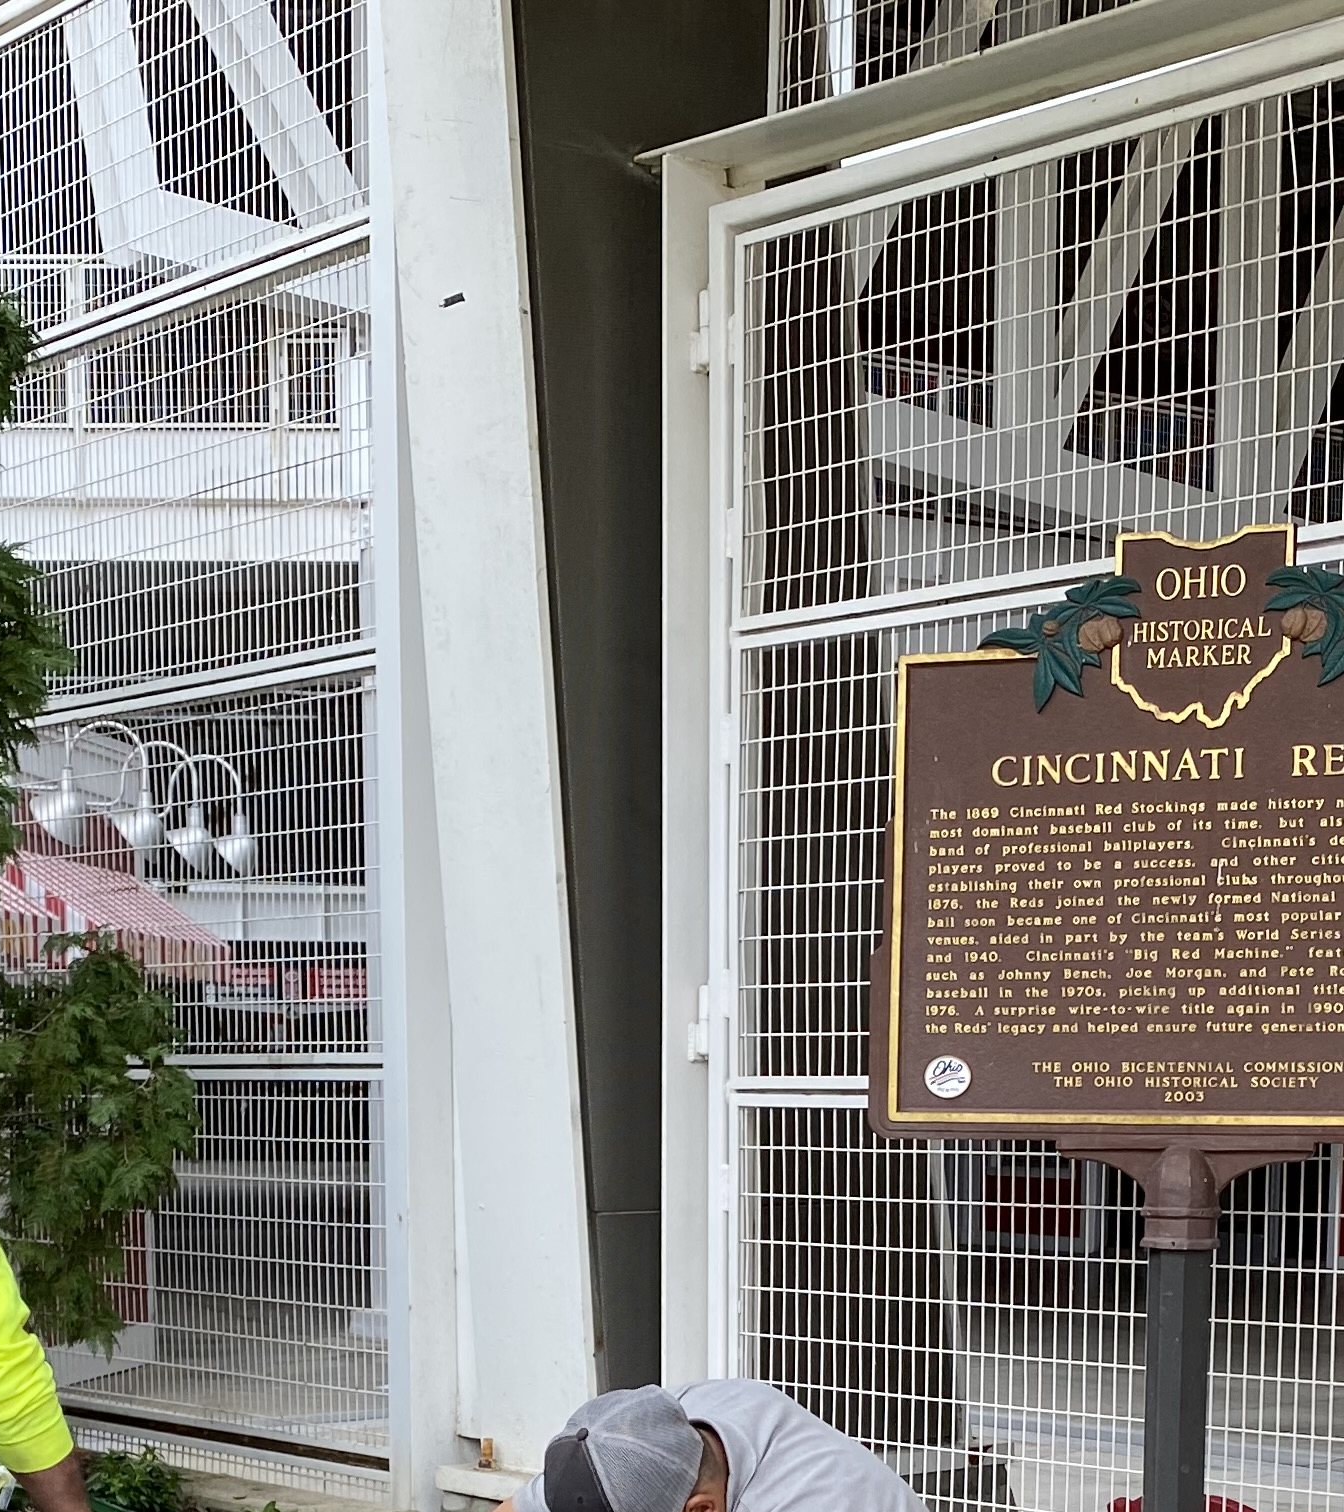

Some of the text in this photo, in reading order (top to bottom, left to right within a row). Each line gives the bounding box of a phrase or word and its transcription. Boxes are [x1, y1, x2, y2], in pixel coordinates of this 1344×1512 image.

[1155, 564, 1247, 600] OHIO
[1133, 616, 1271, 643] HISTORICAL
[1146, 644, 1252, 669] MARKER
[990, 747, 1246, 787] CINCINNATI
[930, 808, 956, 820] The
[966, 807, 998, 819] 1869
[1009, 804, 1084, 817] Cincinnati
[1095, 802, 1122, 815] Red
[1131, 800, 1205, 814] Stockings
[1216, 799, 1257, 811] made
[1267, 797, 1324, 810] history
[929, 826, 962, 839] most
[971, 824, 1038, 837] dominant
[1049, 821, 1111, 834] baseball
[1123, 820, 1155, 832] club
[1167, 819, 1182, 831] of
[1192, 818, 1211, 830] its
[1279, 816, 1303, 828] but
[929, 844, 963, 856] band
[974, 843, 989, 855] of
[1002, 840, 1091, 856] professional
[1103, 839, 1194, 852] ballplayers.
[928, 862, 982, 876] players
[994, 860, 1044, 874] proved
[1056, 860, 1071, 870] to
[1083, 858, 1101, 870] be
[1113, 860, 1121, 869] a
[1210, 855, 1238, 867] and
[1252, 854, 1296, 866] other
[928, 879, 1016, 893] establishing
[1028, 877, 1063, 889] their
[1073, 879, 1101, 888] own
[1113, 874, 1205, 890] professional
[1216, 873, 1257, 886] clubs
[927, 916, 954, 927] ball
[964, 917, 995, 927] soon
[1007, 914, 1062, 926] became
[1072, 915, 1096, 924] one
[1107, 912, 1122, 924] of
[1233, 911, 1269, 922] most
[1280, 909, 1341, 923] popular
[989, 932, 1028, 944] aided
[1039, 932, 1052, 943] in
[1065, 933, 1097, 945] part
[1109, 931, 1127, 944] by
[1139, 931, 1164, 941] the
[1235, 928, 1279, 940] World
[1290, 928, 1340, 939] Series
[926, 952, 951, 962] and
[964, 950, 1001, 962] 1940.
[1171, 947, 1199, 959] Red
[926, 986, 987, 998] baseball
[999, 986, 1012, 997] in
[1024, 986, 1048, 997] the
[1118, 985, 1175, 998] picking
[1187, 987, 1205, 998] up
[1218, 983, 1299, 995] additional
[925, 1005, 959, 1016] 1976.
[974, 1005, 984, 1015] A
[994, 1004, 1055, 1017] surprise
[1068, 1003, 1169, 1014] wire-to-wire
[1181, 1002, 1214, 1014] title
[1226, 1002, 1269, 1016] again
[1280, 1002, 1294, 1013] in
[1307, 1002, 1343, 1013] 1990
[925, 1022, 947, 1033] the
[997, 1022, 1045, 1035] legacy
[1052, 1022, 1078, 1032] and
[1087, 1021, 1138, 1034] helped
[1146, 1023, 1196, 1032] ensure
[1206, 1020, 1252, 1032] future
[933, 1060, 963, 1077] Ohio
[1032, 1061, 1344, 1073] THE OHIO BICENTENNIAL COMMISSION
[1054, 1076, 1319, 1088] THE OHIO HISTORICAL SOCIETY
[1164, 1091, 1205, 1103] 2003
